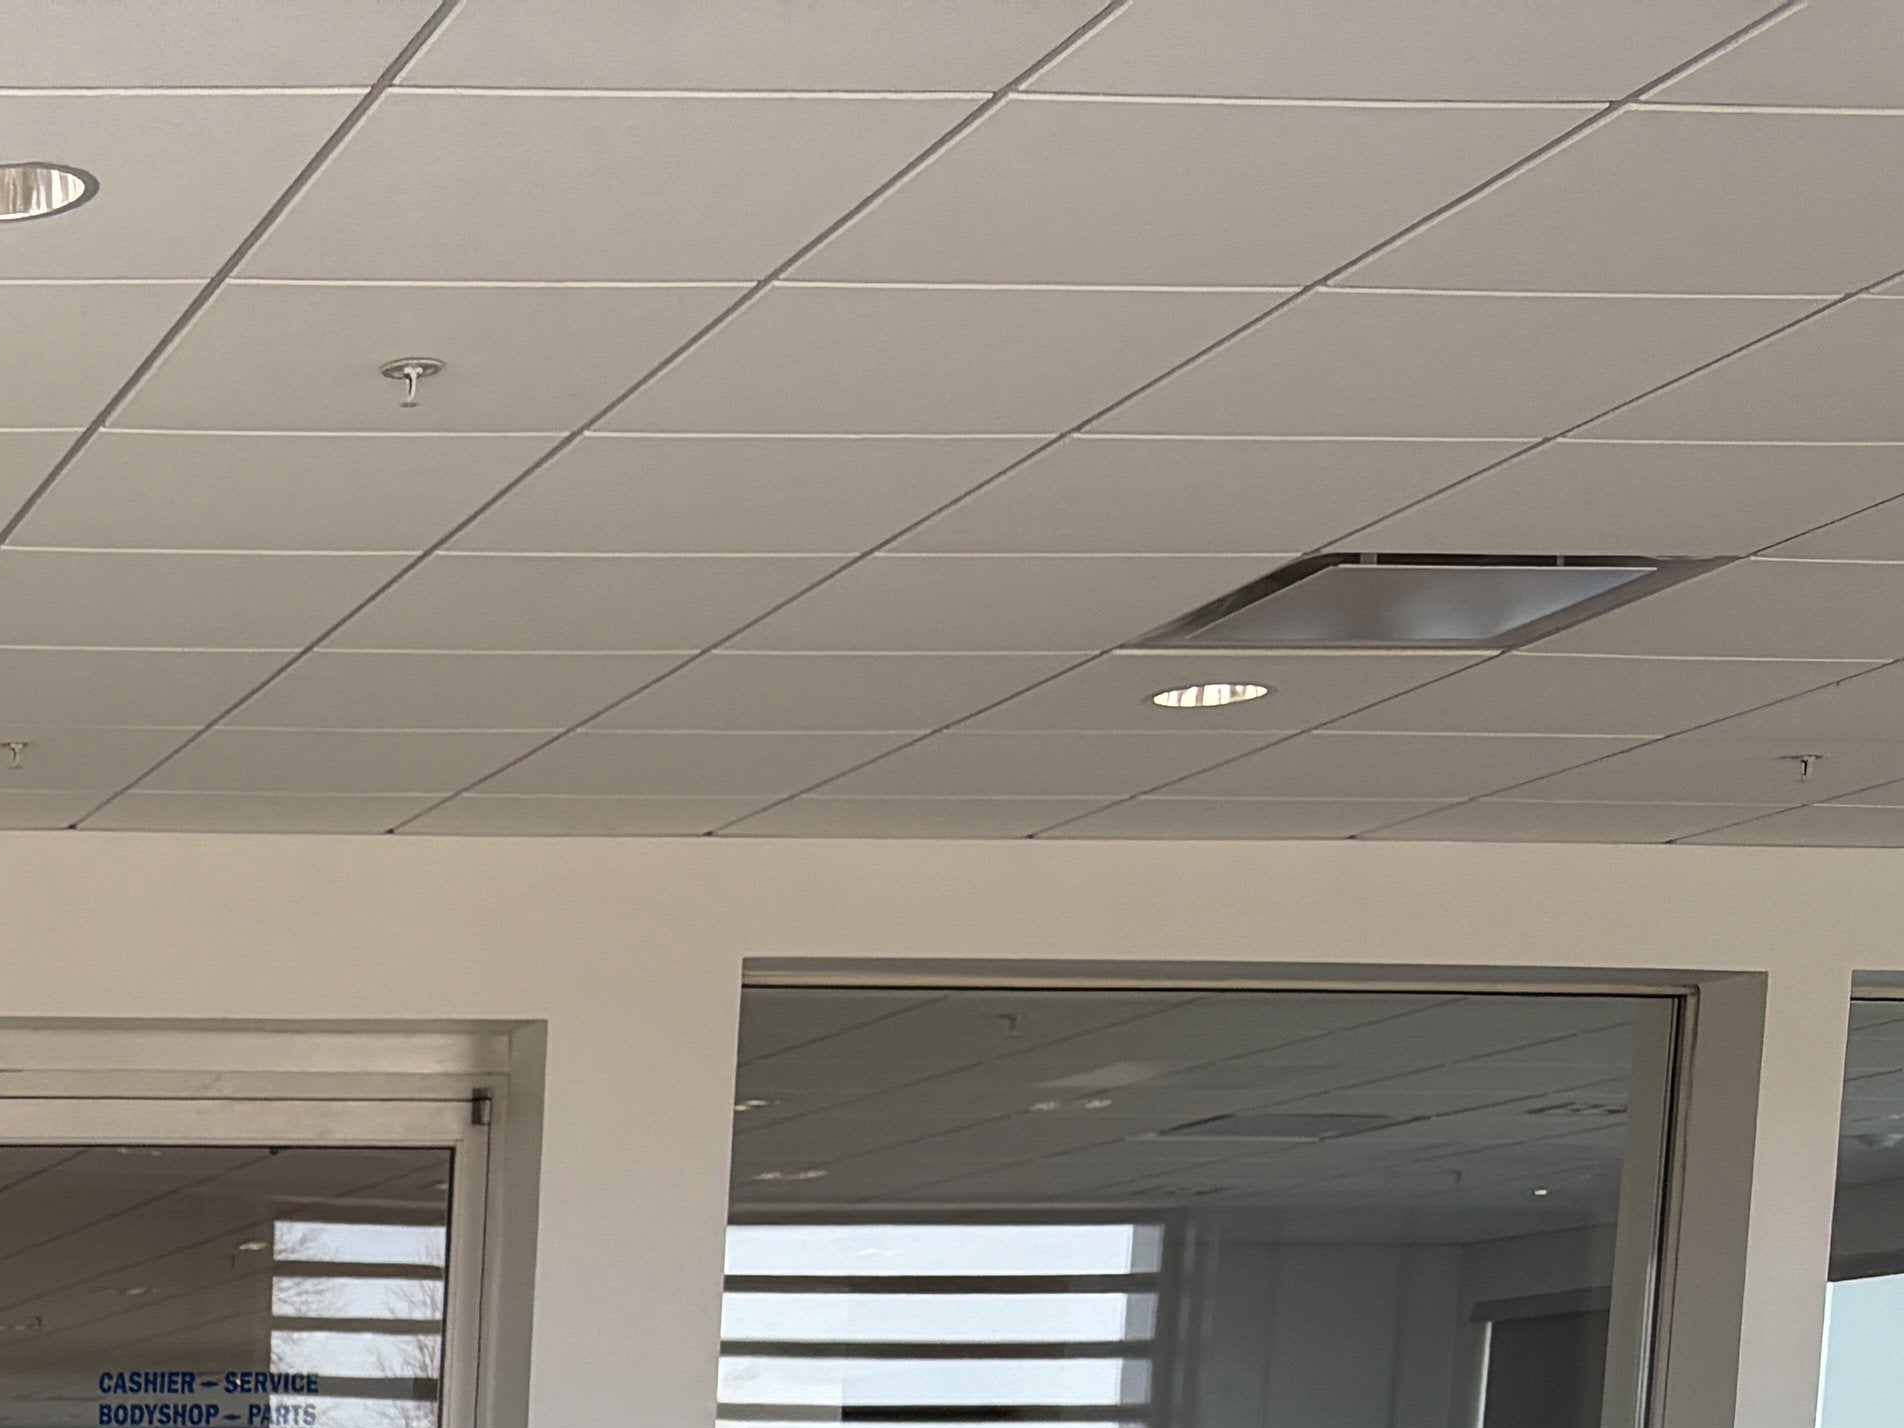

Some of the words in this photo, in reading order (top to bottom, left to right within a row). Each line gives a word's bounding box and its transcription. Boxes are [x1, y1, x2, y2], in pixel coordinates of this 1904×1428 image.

[98, 1372, 196, 1395] CASHIER
[224, 1372, 320, 1395] SERVICE
[98, 1403, 219, 1426] BODYSHOP
[248, 1404, 317, 1426] PARTS
